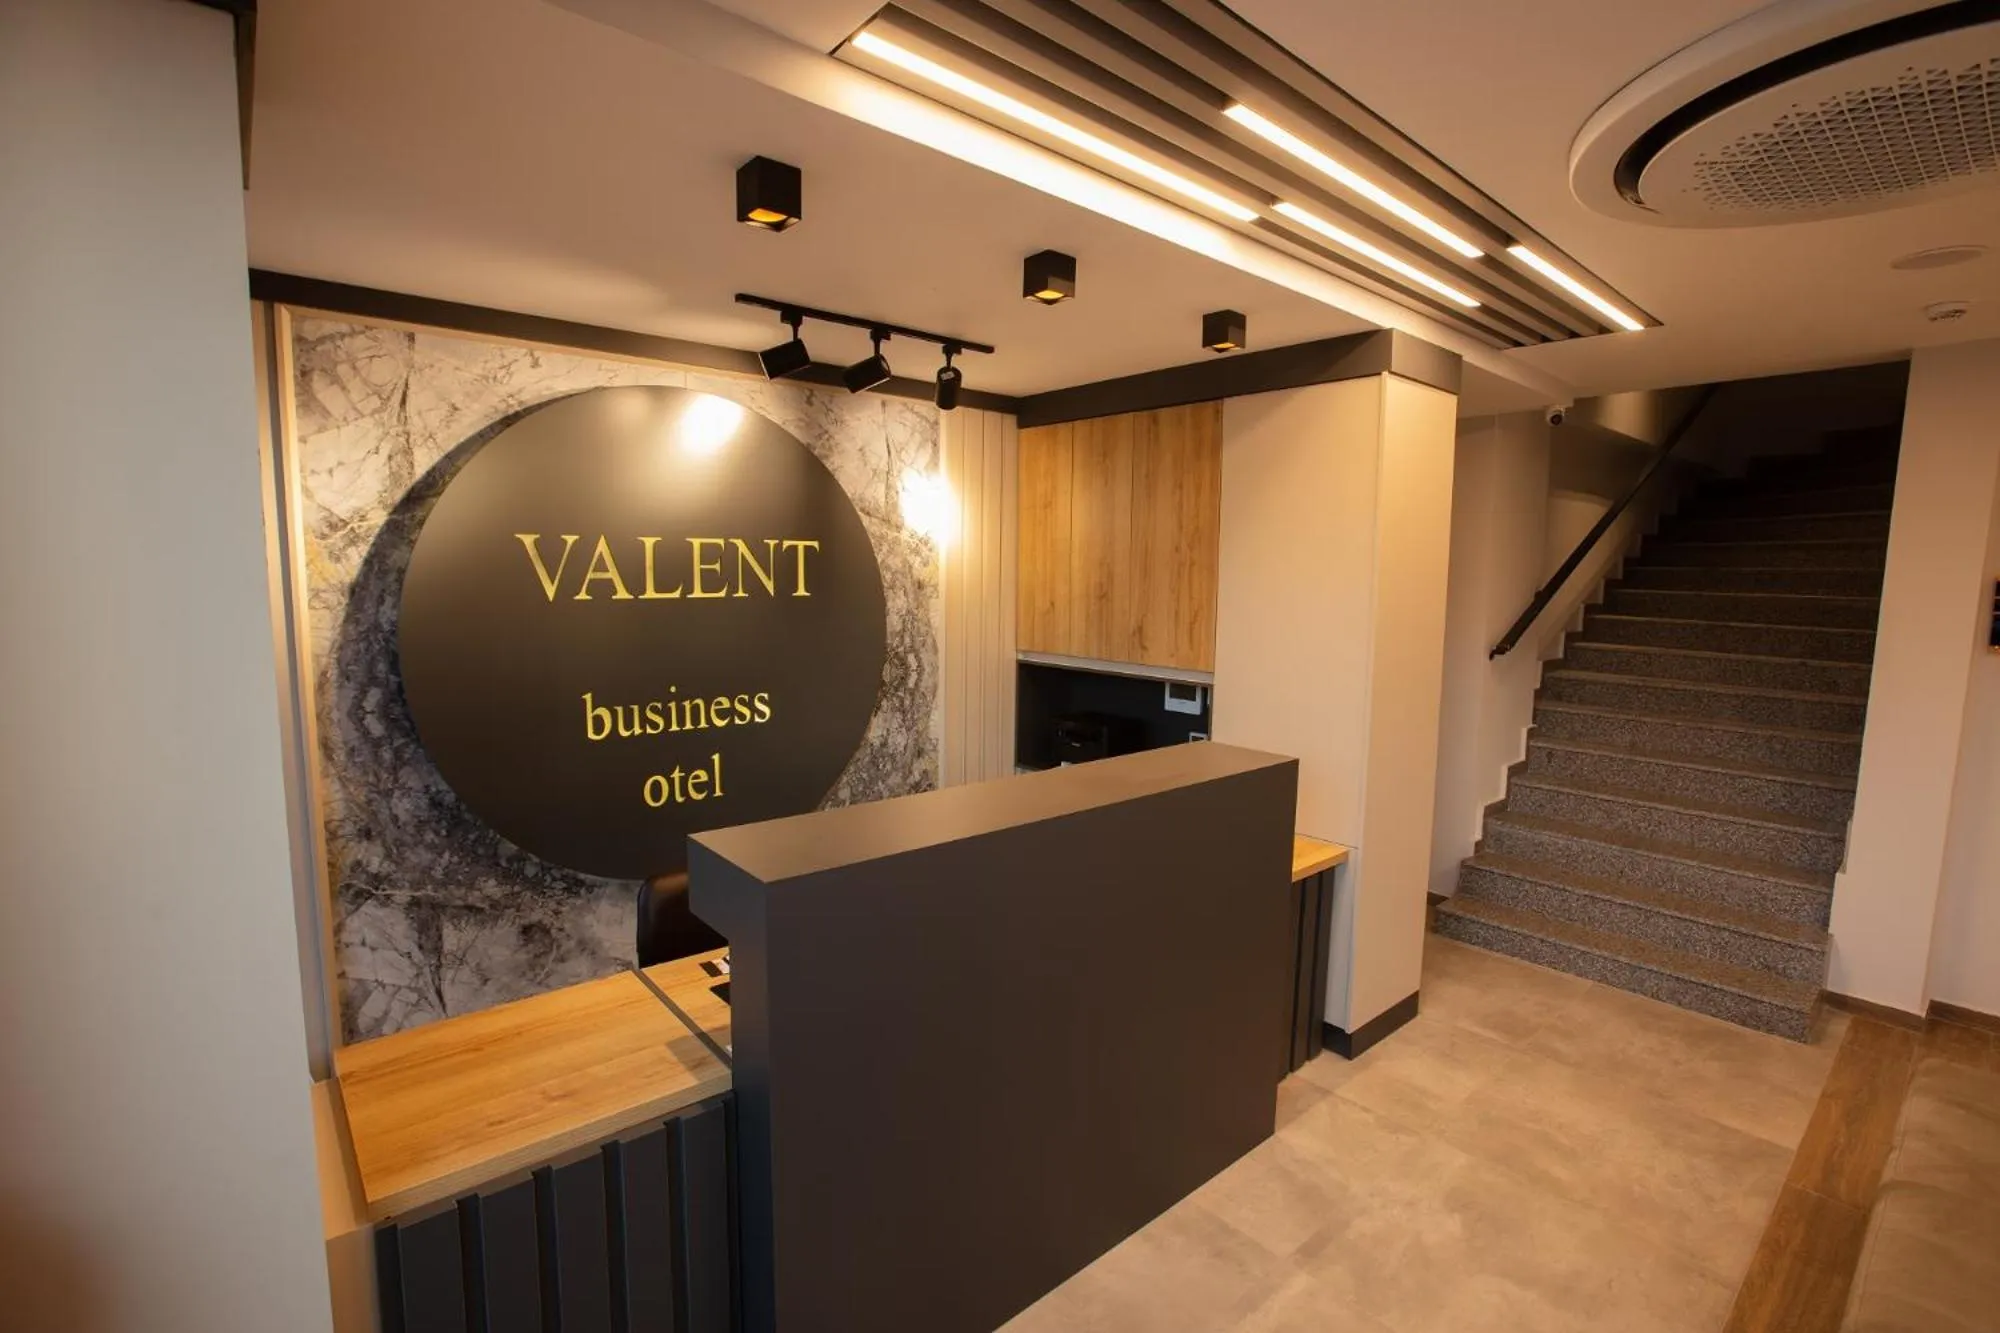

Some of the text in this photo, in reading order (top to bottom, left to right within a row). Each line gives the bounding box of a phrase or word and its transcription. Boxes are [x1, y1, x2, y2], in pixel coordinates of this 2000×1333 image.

[514, 533, 820, 602] VALENT
[582, 686, 771, 740] business
[643, 753, 726, 807] otel
